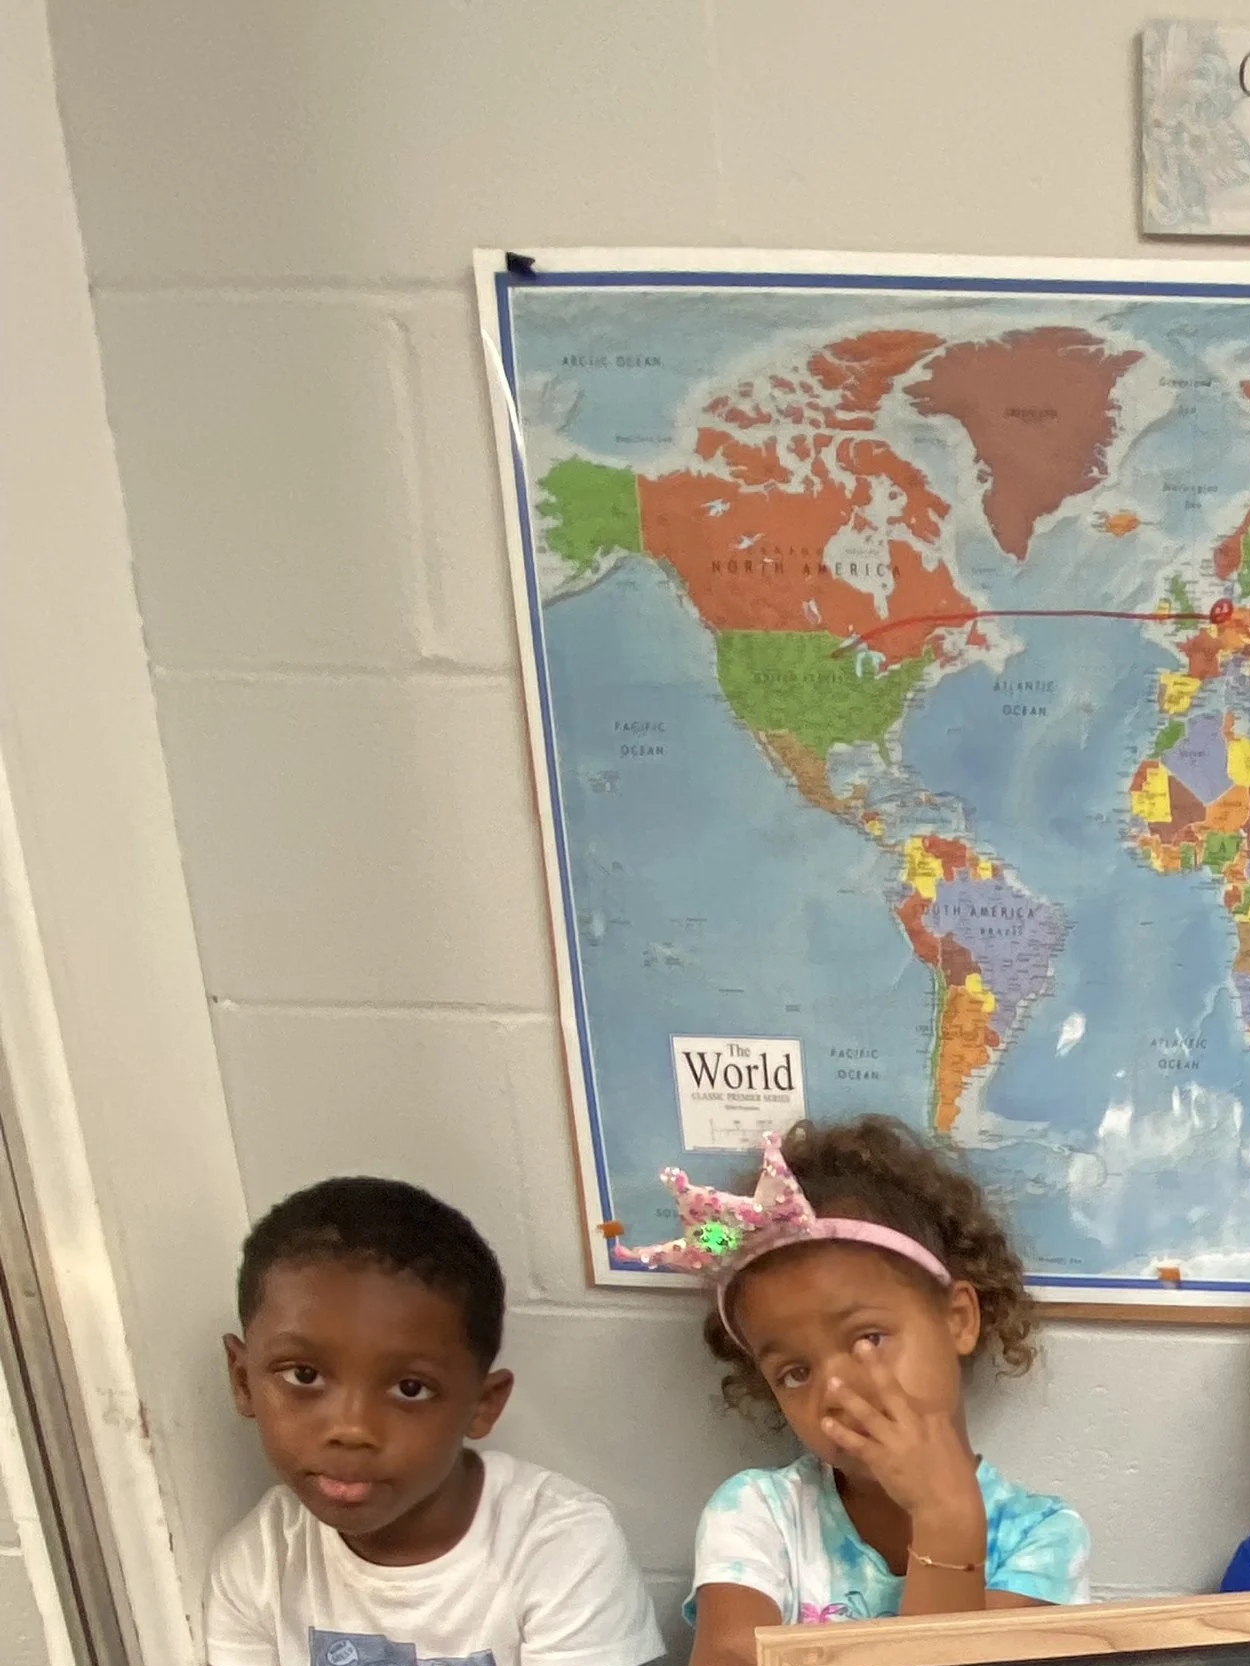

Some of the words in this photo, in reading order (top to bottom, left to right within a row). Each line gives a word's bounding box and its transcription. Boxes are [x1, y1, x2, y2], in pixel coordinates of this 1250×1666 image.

[711, 559, 785, 576] NORTH
[802, 561, 901, 578] AMERICA
[728, 1043, 751, 1058] The
[682, 1051, 796, 1091] World
